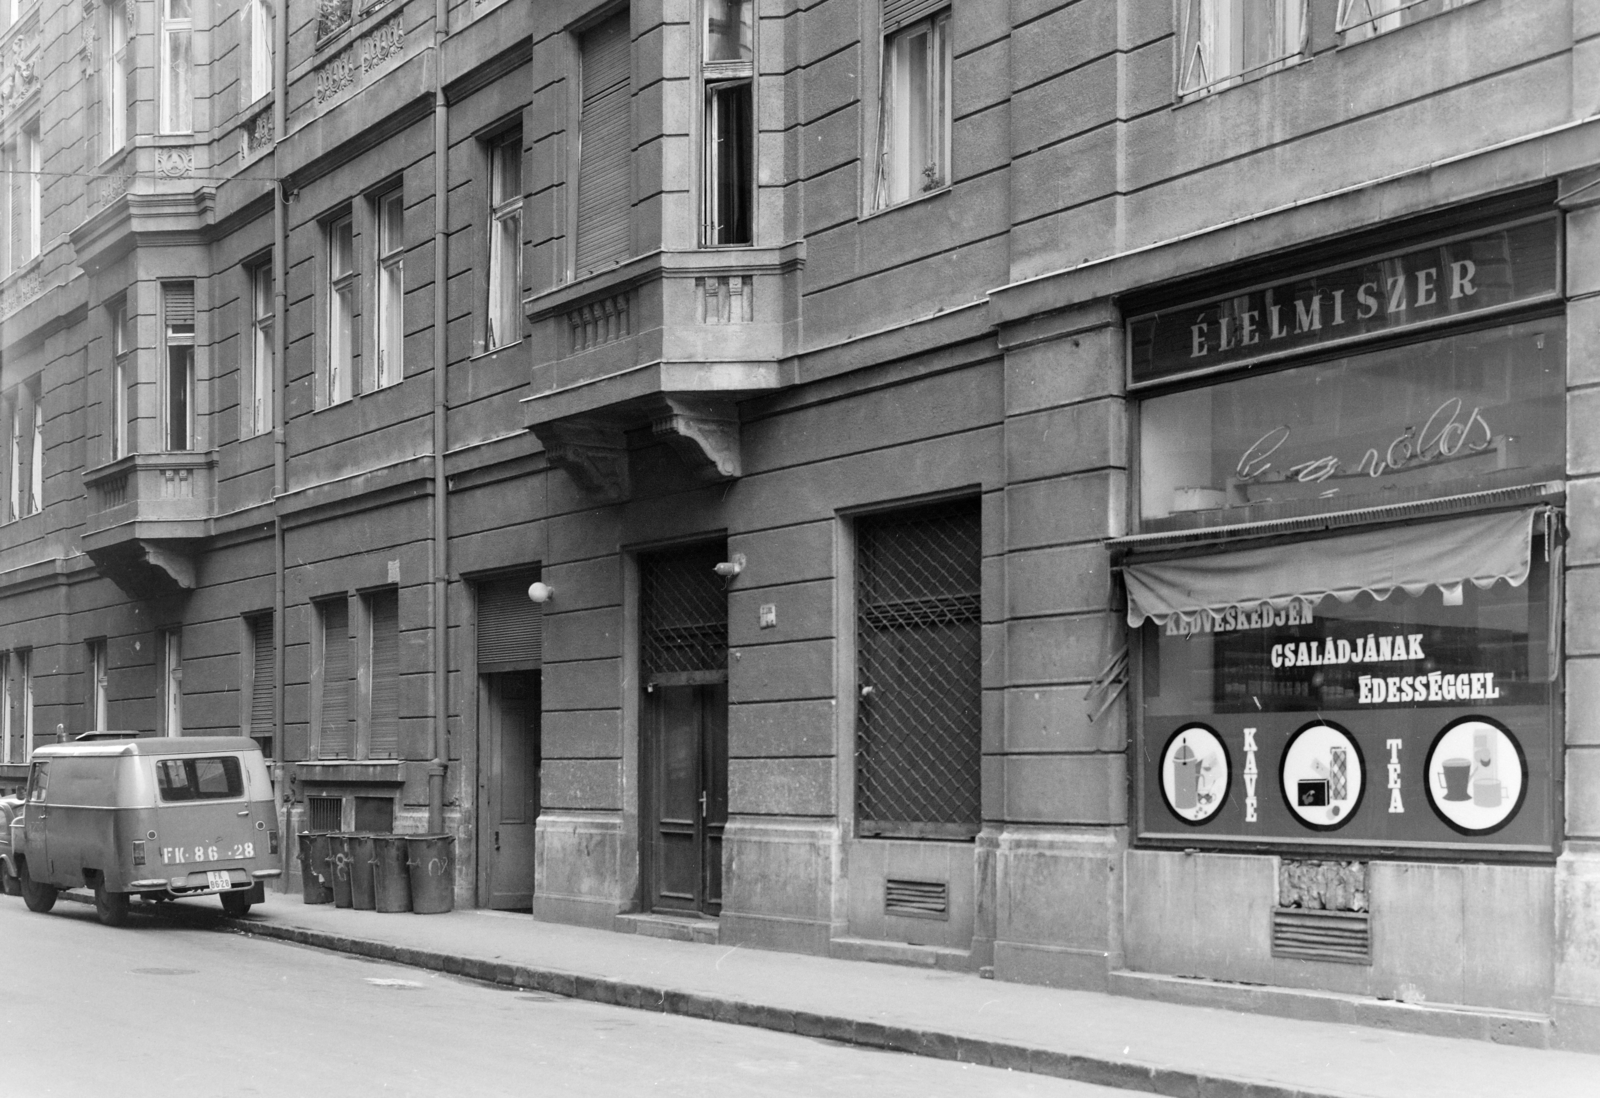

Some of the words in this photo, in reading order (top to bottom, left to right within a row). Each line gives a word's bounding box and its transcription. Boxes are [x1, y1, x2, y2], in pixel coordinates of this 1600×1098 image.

[1190, 259, 1478, 358] ÉLELMISZER
[1270, 633, 1426, 669] CSALÁDJÁNAK
[1358, 670, 1500, 704] ÉDESSÉGGEL
[1386, 738, 1405, 813] TEA
